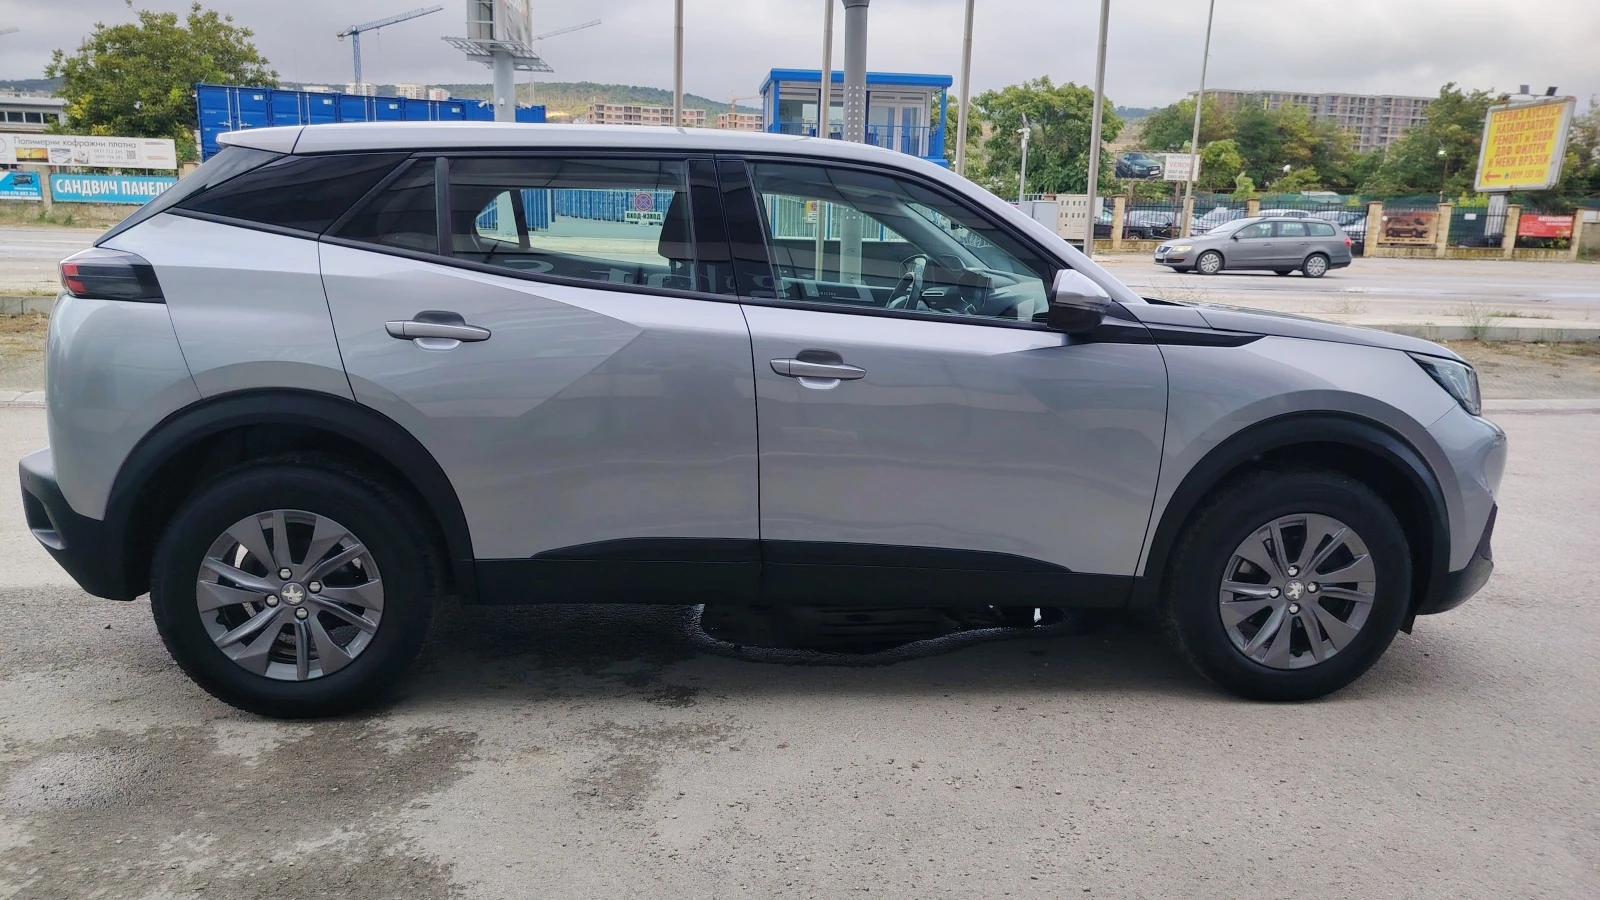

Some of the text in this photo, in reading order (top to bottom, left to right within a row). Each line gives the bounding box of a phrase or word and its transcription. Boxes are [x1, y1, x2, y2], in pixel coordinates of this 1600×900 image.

[1493, 110, 1523, 123] СЕРВИЗ
[1496, 117, 1556, 134] КАТАЛИЗАТОРИ
[13, 136, 137, 148] Полимерни кофражни платна
[1493, 133, 1523, 146] РЕМОНТ
[1532, 130, 1554, 142] НОВИ
[1515, 142, 1547, 155] ФИЛТРИ
[1495, 156, 1517, 168] МЕКИ
[1518, 153, 1550, 166] ВРЪЗКИ
[55, 178, 118, 197] САНДВИЧ
[626, 212, 661, 220] ВХОД-ИЗХОД
